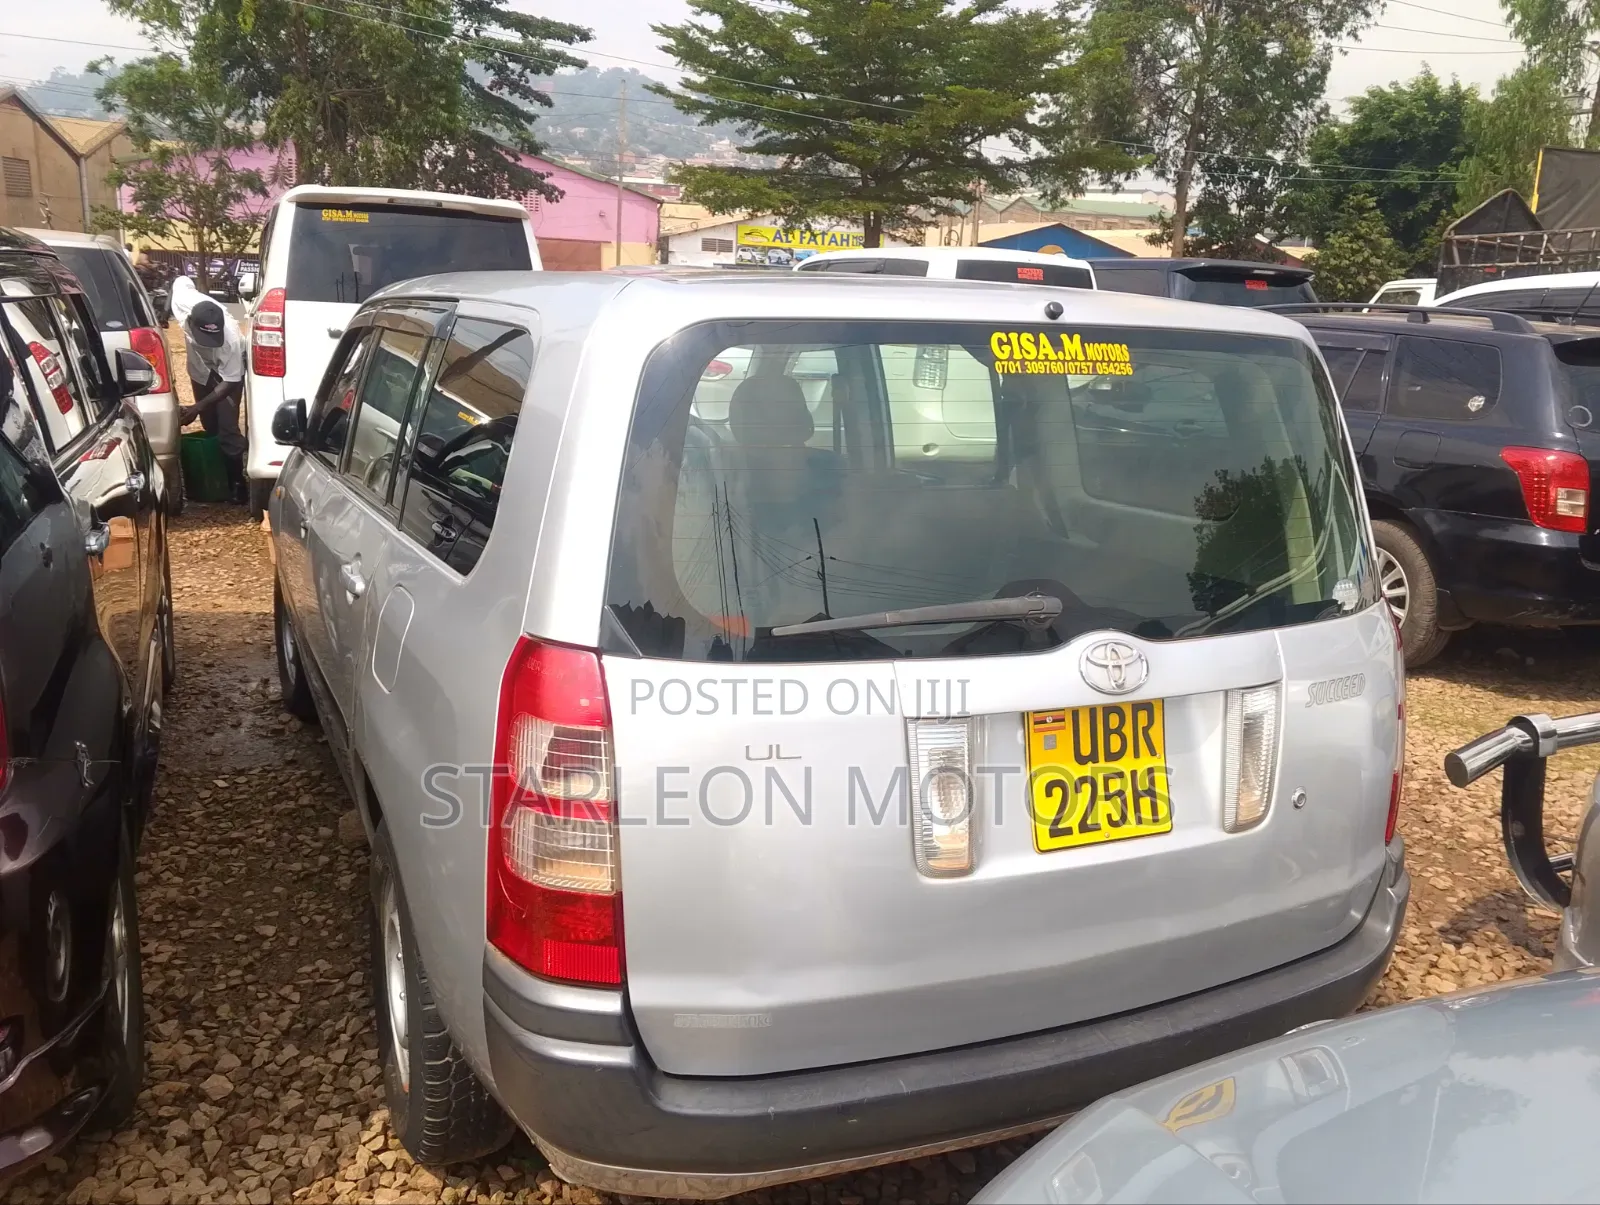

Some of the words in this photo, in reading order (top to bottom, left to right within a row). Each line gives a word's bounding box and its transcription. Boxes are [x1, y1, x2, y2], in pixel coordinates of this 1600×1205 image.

[322, 209, 352, 218] GISA.M
[800, 232, 850, 247] FATAH
[990, 332, 1085, 361] GISA.M
[1084, 342, 1130, 362] MOTORS
[995, 361, 1022, 374] 0701
[1096, 363, 1133, 375] 054256
[1304, 672, 1366, 708] SUCCEED
[1072, 702, 1157, 766] UBR
[1045, 766, 1160, 839] 225H
